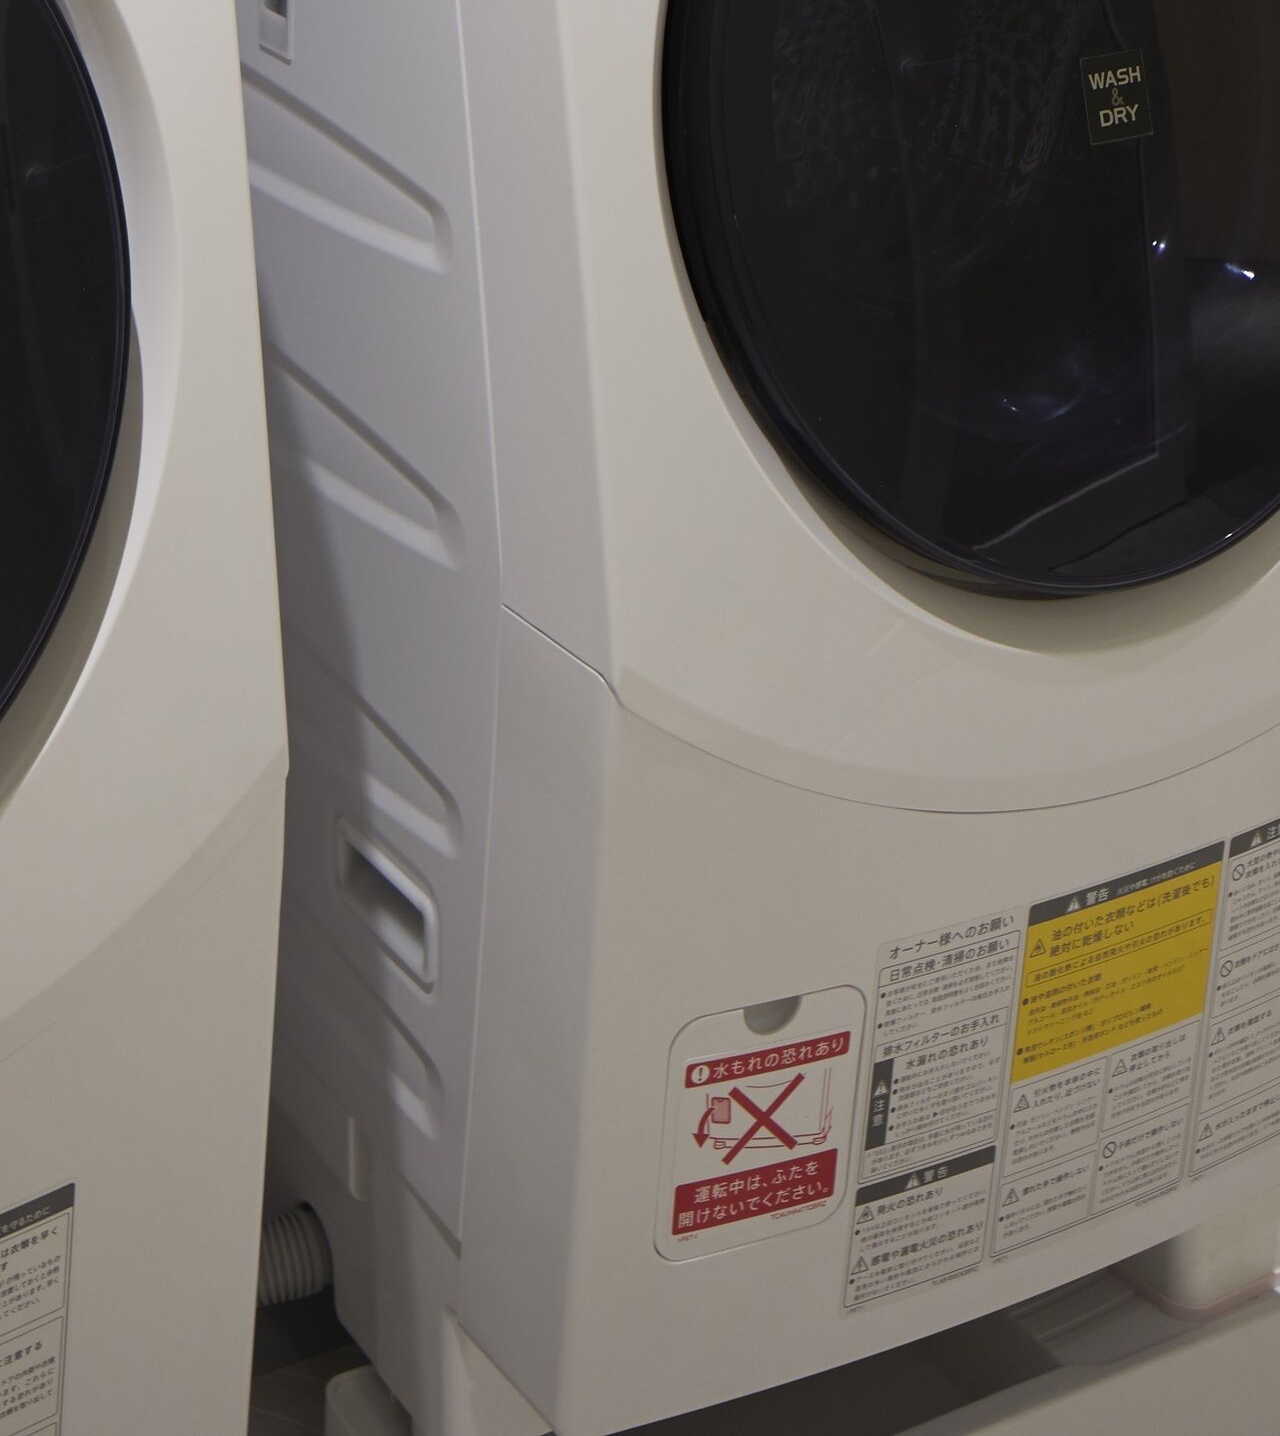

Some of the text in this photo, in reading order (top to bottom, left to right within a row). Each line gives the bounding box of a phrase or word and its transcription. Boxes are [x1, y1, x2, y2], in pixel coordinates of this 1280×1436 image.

[1088, 66, 1141, 90] WASH
[1112, 88, 1125, 106] &
[1099, 104, 1138, 127] DRY
[713, 1037, 844, 1079] 水もれの恐れあり
[694, 1161, 819, 1204] 運転中は、ふたを
[678, 1180, 829, 1229] 開けないでください。
